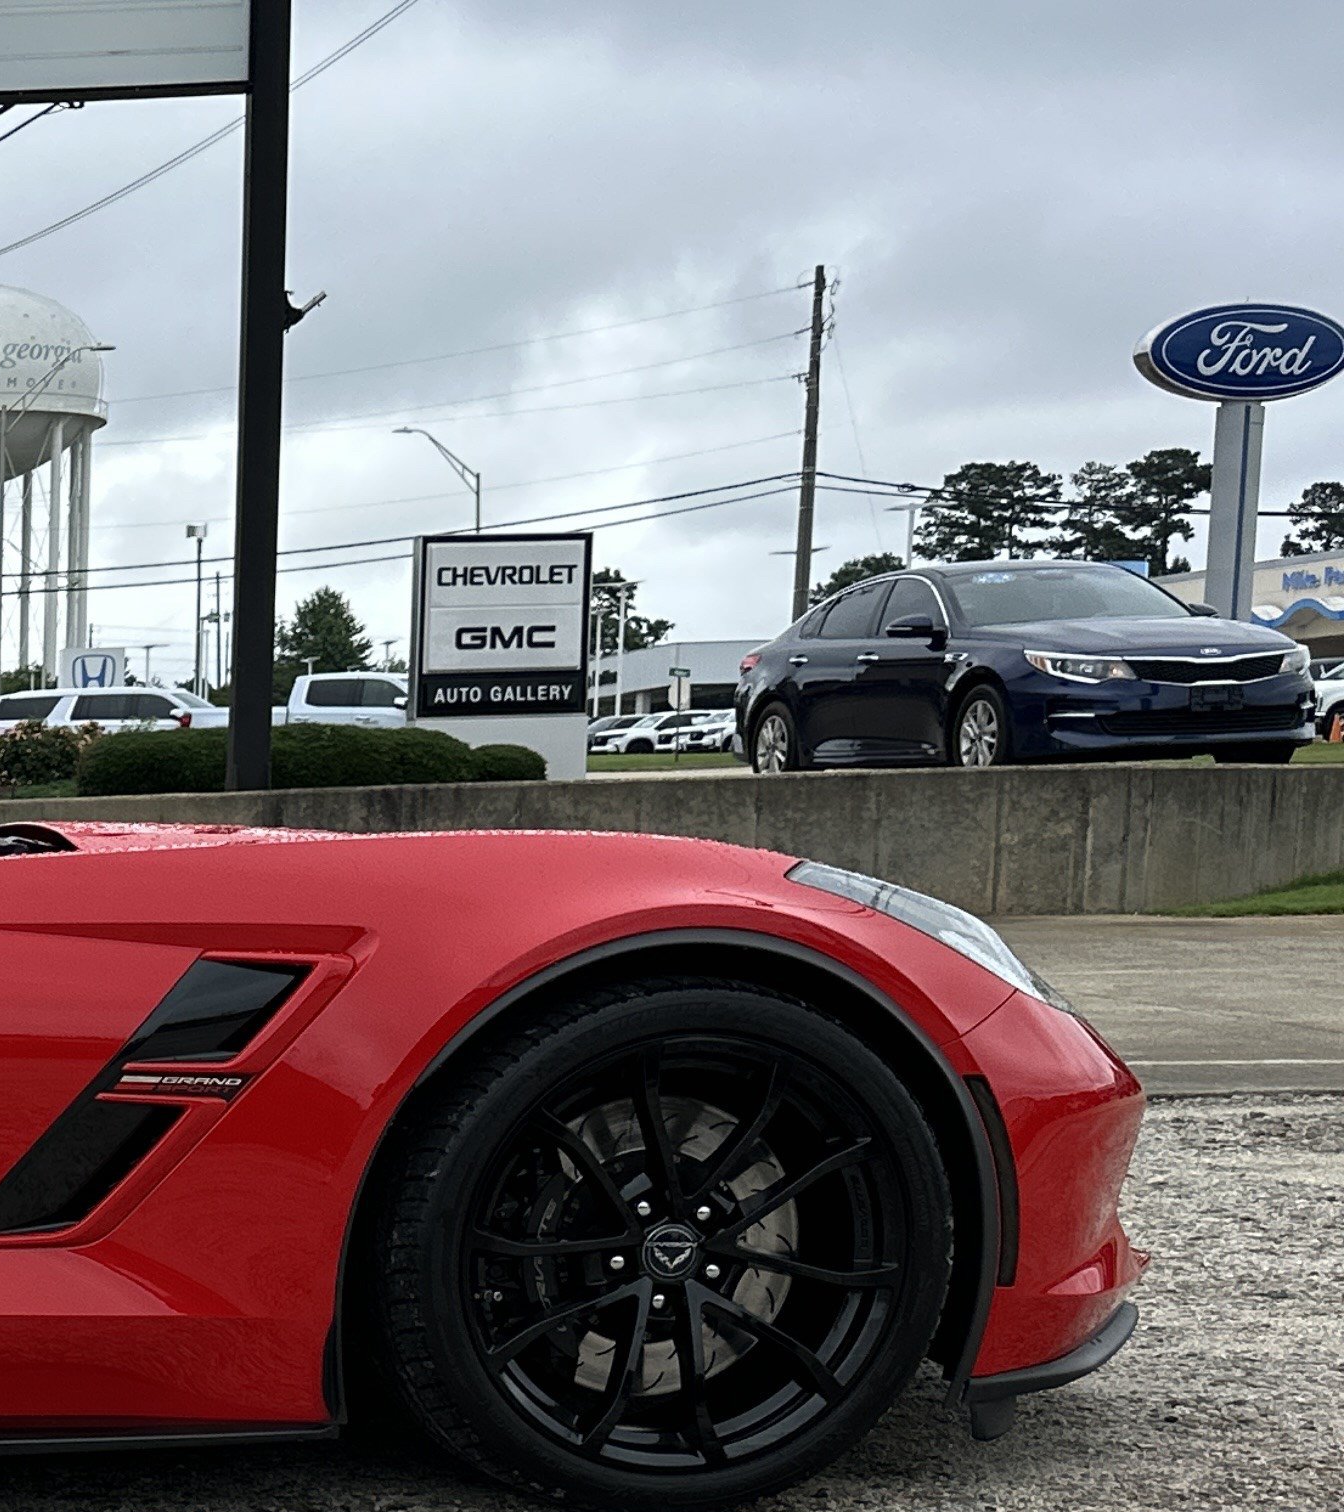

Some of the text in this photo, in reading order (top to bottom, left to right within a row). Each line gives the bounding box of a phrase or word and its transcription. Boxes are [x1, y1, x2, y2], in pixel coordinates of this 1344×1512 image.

[1197, 321, 1316, 376] Ford
[437, 564, 578, 587] CHEVROLET
[455, 625, 556, 650] GMC
[433, 684, 573, 704] AUTO GALLERY
[156, 1084, 235, 1094] SPORT
[161, 1076, 242, 1086] GRAND
